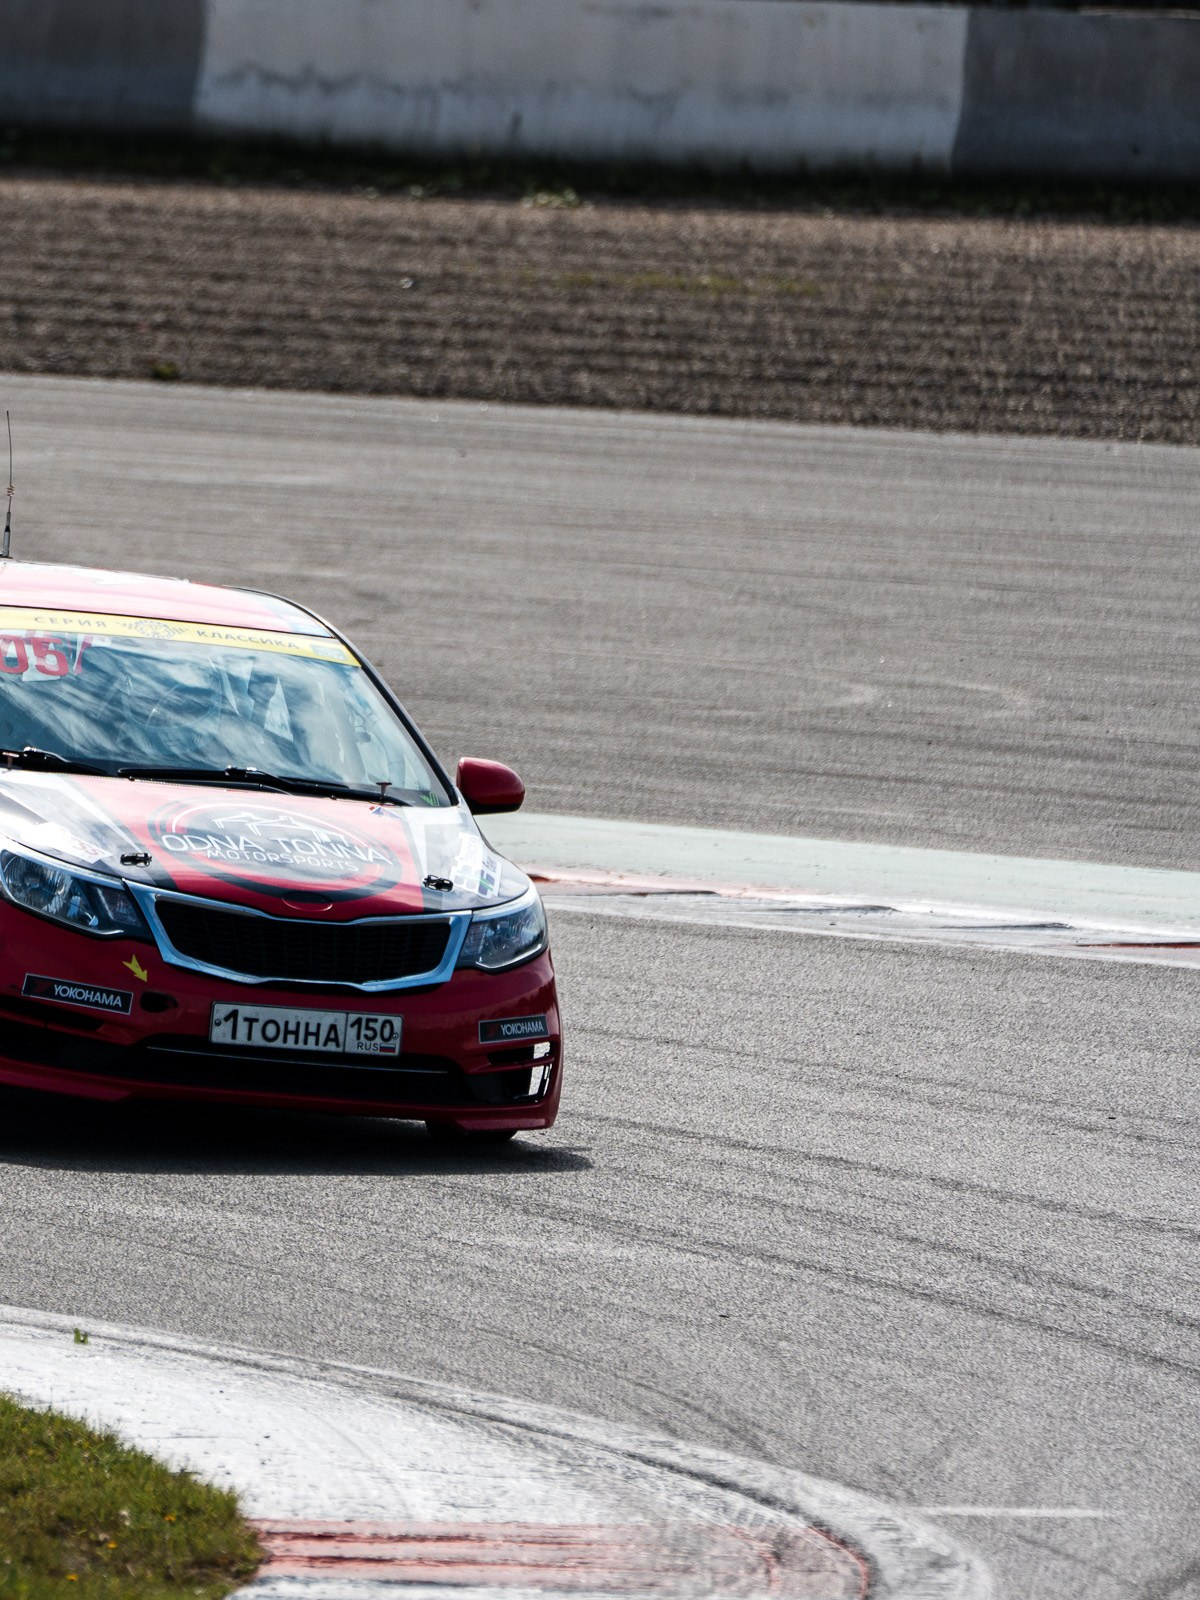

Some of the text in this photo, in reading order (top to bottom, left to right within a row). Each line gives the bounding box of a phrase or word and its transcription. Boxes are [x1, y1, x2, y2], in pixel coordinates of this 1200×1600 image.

[34, 616, 300, 649] СЕРИЯ КЛАССИКА
[161, 834, 395, 866] ODNA TONNA
[206, 849, 360, 872] MOTORSPORTS
[54, 984, 122, 1008] YOKOHAMA
[223, 1009, 395, 1048] 1ТОННА 150
[501, 1021, 544, 1036] YOKOHAMA
[356, 1041, 379, 1052] RUS
